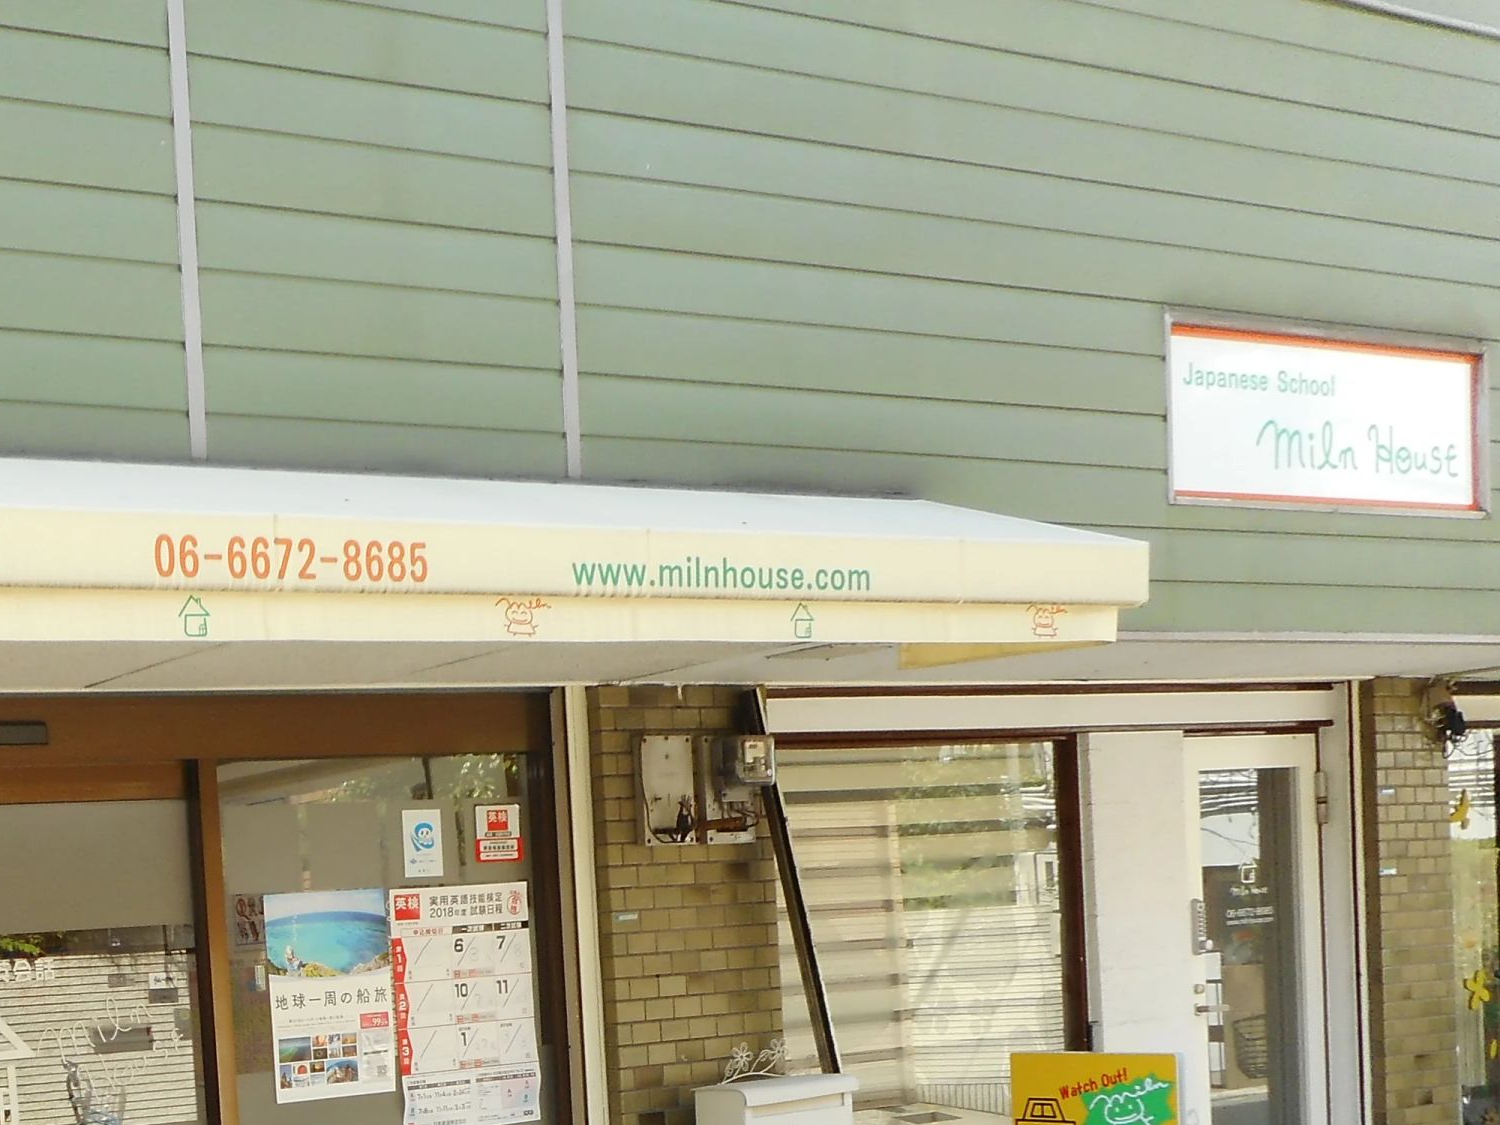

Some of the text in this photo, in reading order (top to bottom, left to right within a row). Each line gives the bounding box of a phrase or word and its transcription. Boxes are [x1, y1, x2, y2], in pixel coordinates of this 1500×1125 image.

[1182, 362, 1336, 398] Japanese School
[1367, 424, 1459, 478] House
[154, 533, 428, 583] 06-6672-8685
[571, 556, 871, 592] www.milnhouse.com
[394, 895, 420, 911] 英検
[453, 938, 464, 953] 6
[496, 935, 506, 950] 7
[275, 986, 388, 1011] 地球一周の船旅
[454, 983, 469, 998] 10
[496, 979, 509, 994] 11
[1059, 1067, 1129, 1100] Watch Out!
